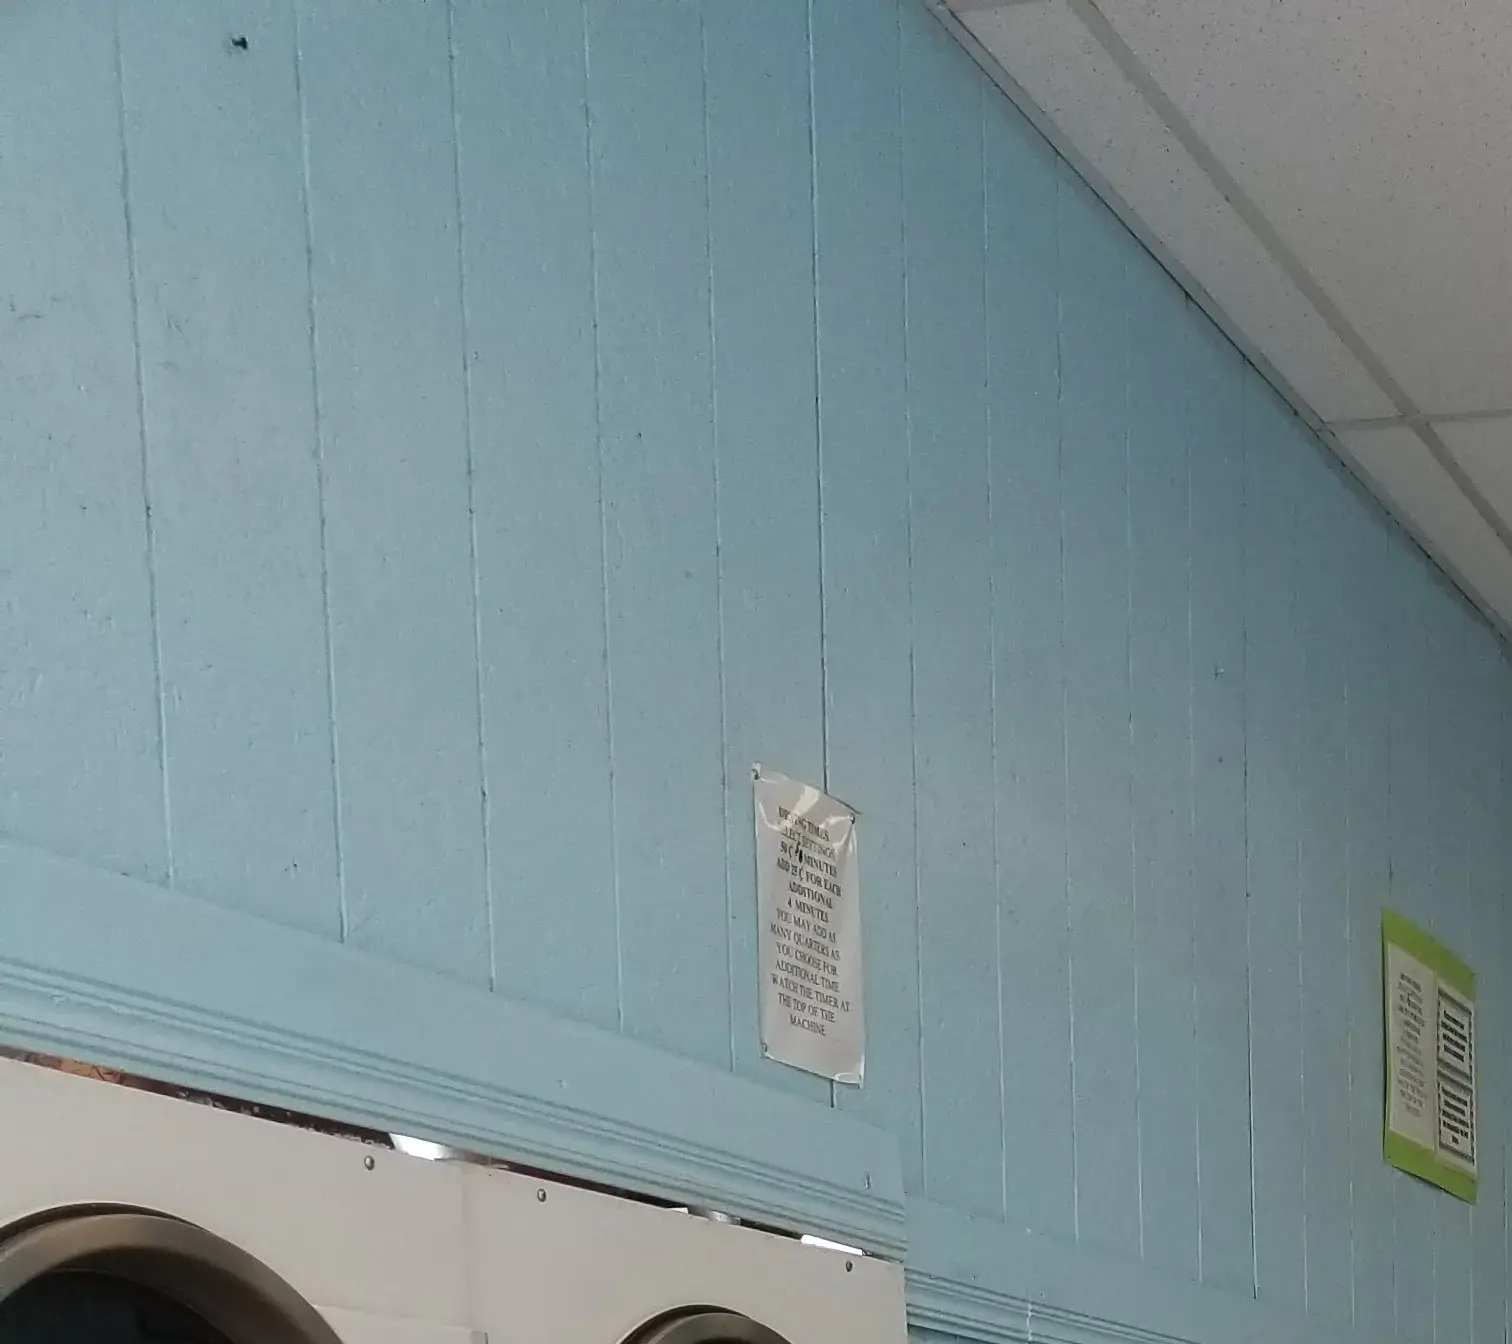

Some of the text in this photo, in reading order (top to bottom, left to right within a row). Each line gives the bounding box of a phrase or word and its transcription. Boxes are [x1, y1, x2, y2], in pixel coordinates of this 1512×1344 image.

[804, 854, 837, 878] MINUTES
[805, 870, 822, 888] FOR
[788, 880, 834, 910] ADDITIONAL
[795, 899, 829, 923] MINUTES
[770, 922, 792, 941] MANY
[793, 932, 829, 957] QUARTERS
[793, 914, 810, 932] MAY
[813, 924, 827, 939] ADD
[776, 941, 793, 958] YOU
[823, 961, 838, 977] FOR
[770, 972, 799, 994] WATCH
[800, 984, 814, 1001] THE
[814, 990, 839, 1009] TIMER
[775, 959, 840, 993] ADDITIONAL TIME
[778, 992, 836, 1023] THE TOP OF THE
[789, 1013, 826, 1037] MACHINE
